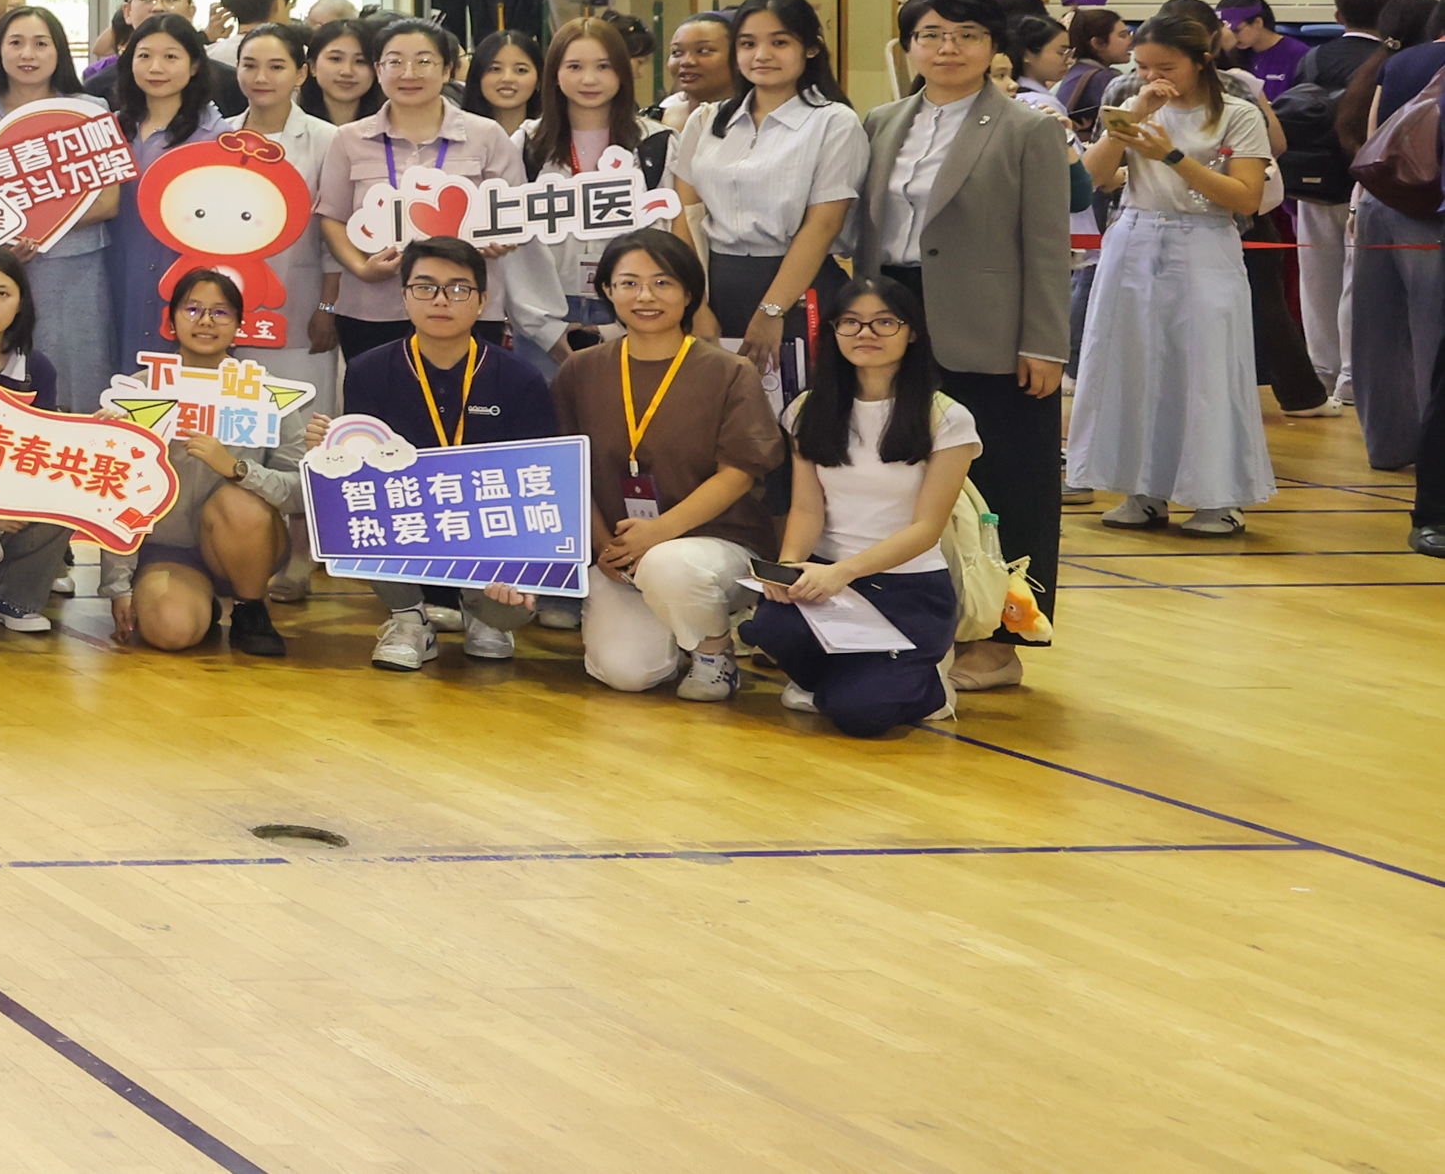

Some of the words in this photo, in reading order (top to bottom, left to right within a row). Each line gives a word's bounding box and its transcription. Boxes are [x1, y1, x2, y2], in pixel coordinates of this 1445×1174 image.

[472, 178, 636, 239] 上中医
[138, 354, 262, 401] 下一站
[341, 464, 556, 513] 智能有温度
[347, 501, 563, 550] 热爱有回响
